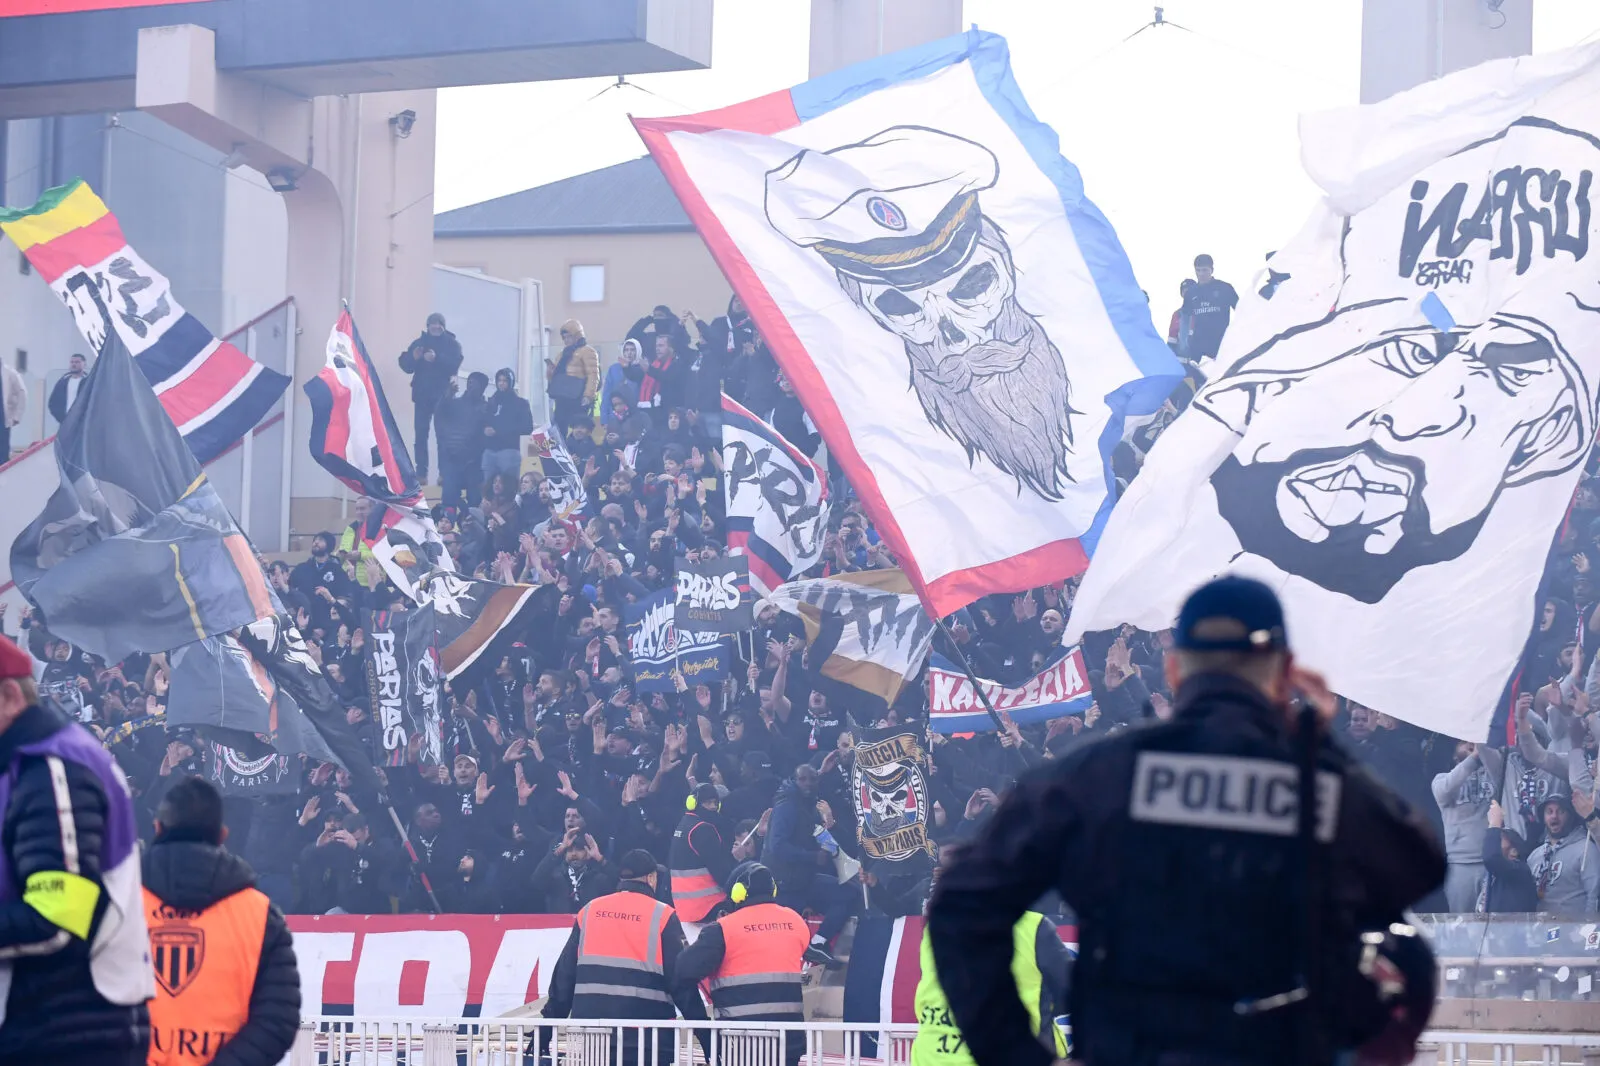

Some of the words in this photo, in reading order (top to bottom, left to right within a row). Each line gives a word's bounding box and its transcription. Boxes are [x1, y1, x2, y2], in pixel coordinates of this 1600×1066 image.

[675, 570, 741, 610] PARIAS
[371, 628, 408, 751] PARIAS
[231, 772, 270, 787] PARIS
[1144, 766, 1322, 834] POLIC
[595, 910, 642, 922] SECURITE
[743, 922, 794, 933] SECURITE
